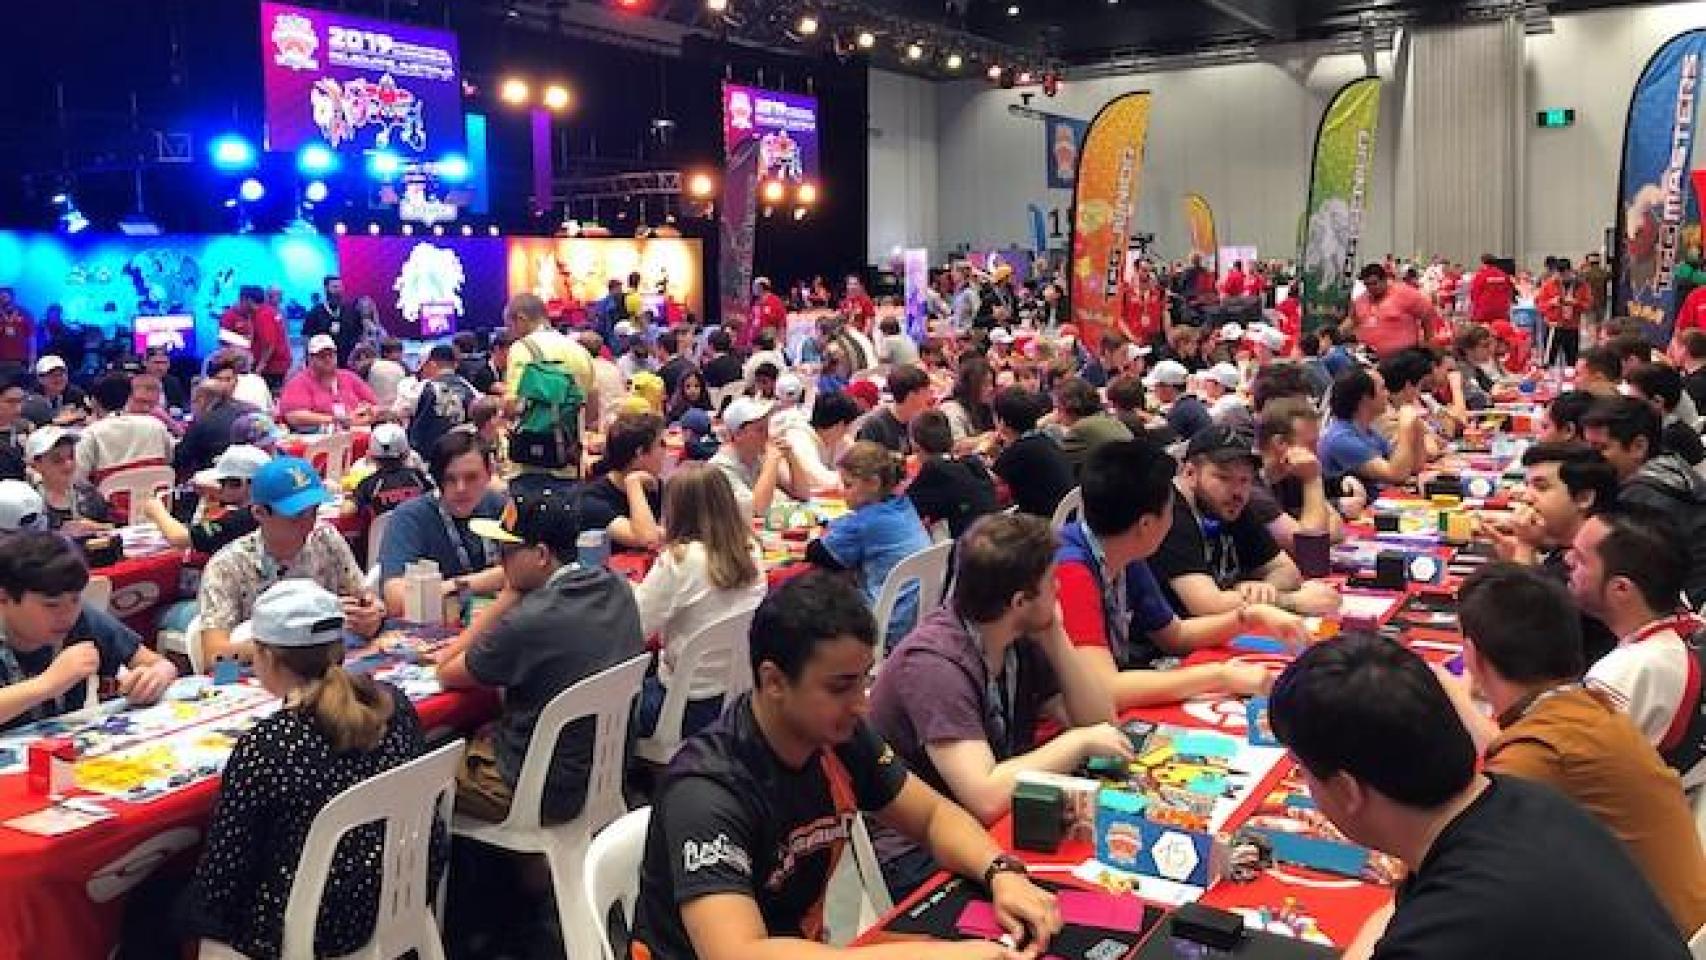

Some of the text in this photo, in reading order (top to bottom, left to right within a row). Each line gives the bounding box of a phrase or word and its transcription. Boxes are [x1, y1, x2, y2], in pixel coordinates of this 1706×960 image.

[328, 26, 392, 54] 2019
[1662, 53, 1698, 223] MASTERS
[1105, 145, 1136, 297] TCG JUNIOR
